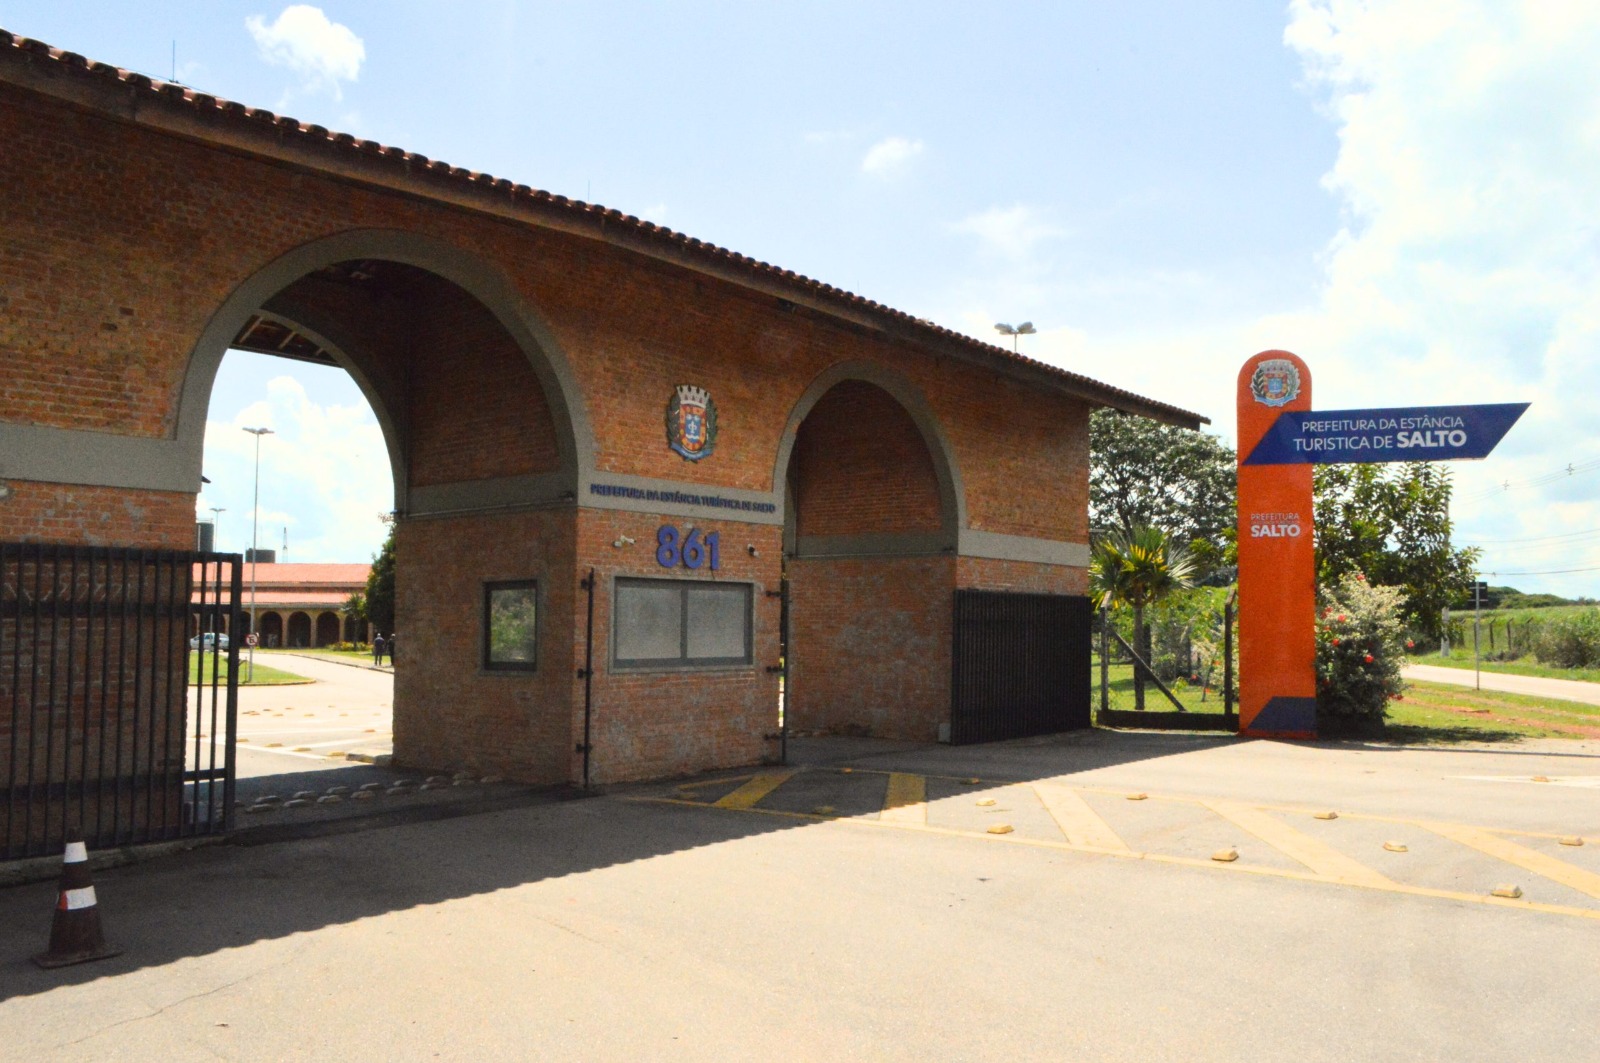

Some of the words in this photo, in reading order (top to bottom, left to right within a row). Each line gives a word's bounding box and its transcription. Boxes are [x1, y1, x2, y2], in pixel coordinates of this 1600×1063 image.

[1302, 420, 1377, 433] PREFEITURA
[1380, 418, 1398, 430] DA
[1400, 415, 1464, 429] ESTÂNCIA
[1293, 437, 1371, 451] TURISTICA
[1373, 435, 1393, 449] DE
[1396, 430, 1467, 448] SALTO
[590, 483, 645, 499] PREFEITURA
[646, 489, 659, 501] DA
[1251, 512, 1299, 521] PREFEITURA
[1251, 524, 1301, 537] SALTO
[656, 524, 719, 570] 861
